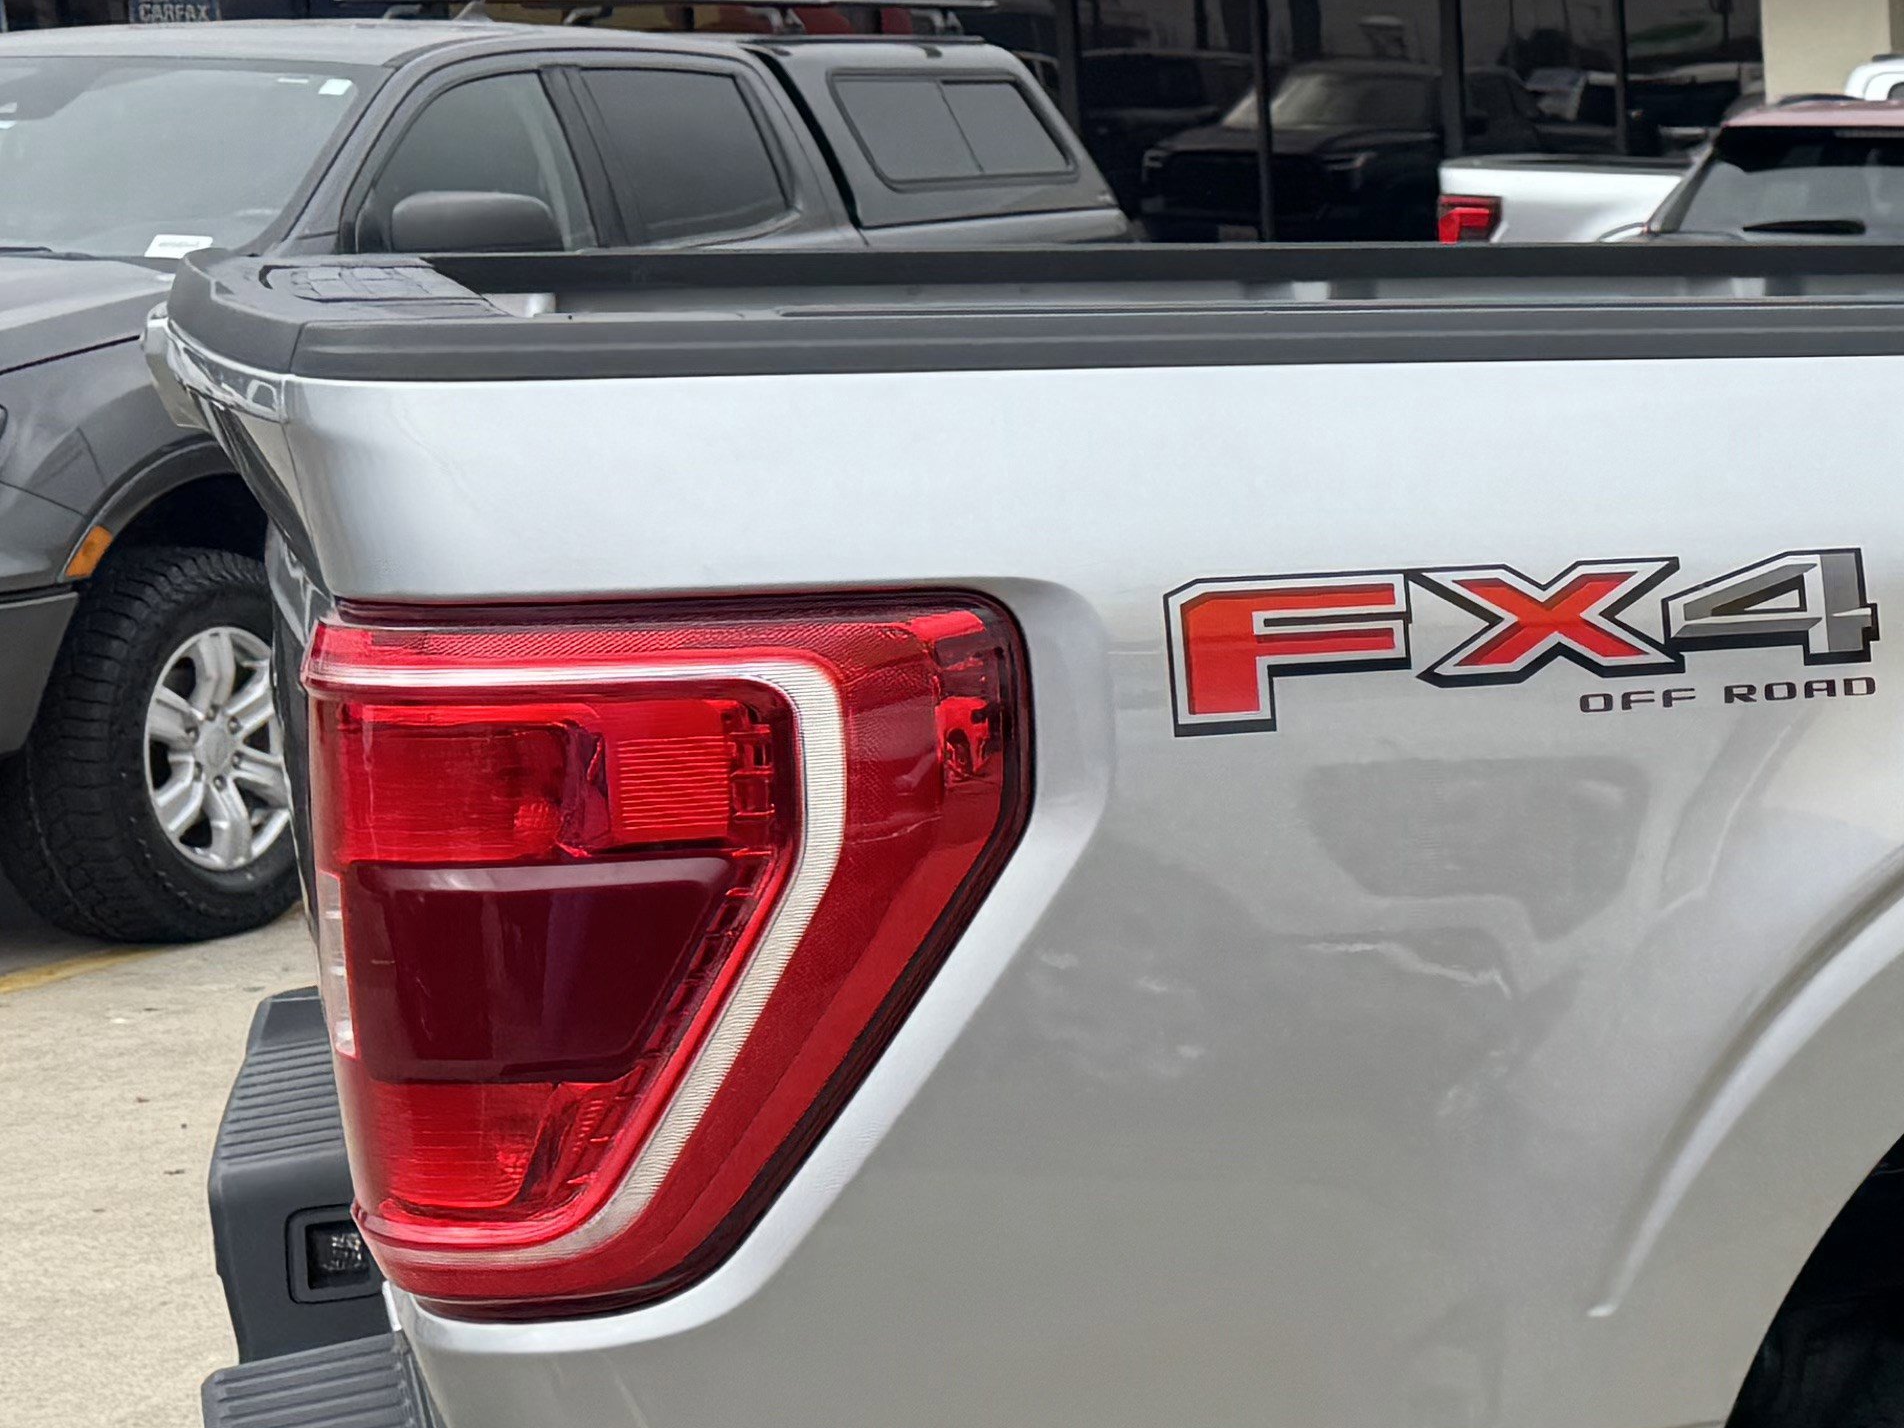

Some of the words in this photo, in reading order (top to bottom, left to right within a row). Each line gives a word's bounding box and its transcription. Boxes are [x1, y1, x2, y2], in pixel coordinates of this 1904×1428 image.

[138, 4, 210, 25] CARFAX
[1164, 547, 1879, 737] FX4
[1579, 687, 1696, 713] OFF
[1723, 676, 1876, 704] ROAD
